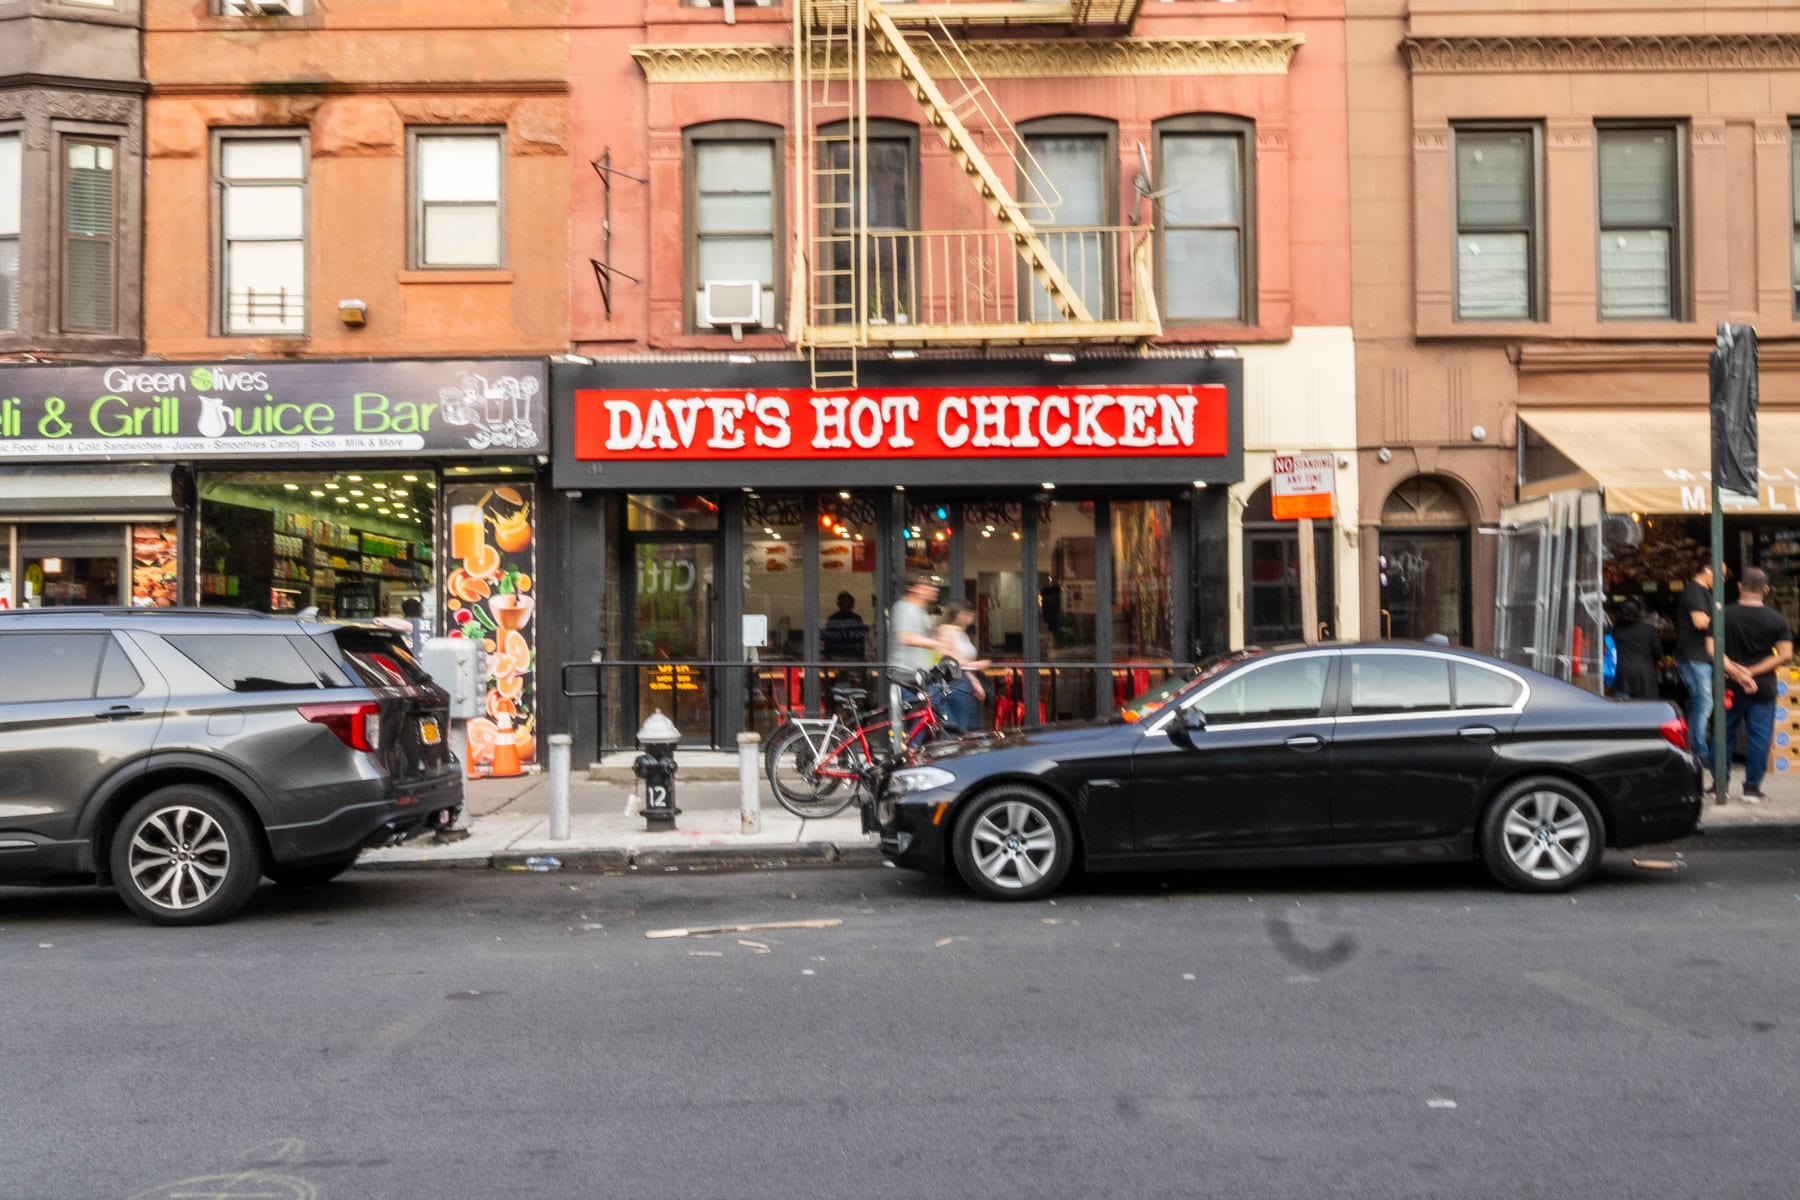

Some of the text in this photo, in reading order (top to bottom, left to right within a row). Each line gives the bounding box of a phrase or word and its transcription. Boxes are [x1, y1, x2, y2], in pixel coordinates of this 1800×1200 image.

[103, 367, 186, 393] Green
[0, 397, 21, 437] li
[38, 397, 73, 438] &
[89, 395, 180, 437] Grill
[353, 392, 438, 433] Bar
[603, 392, 1199, 450] DAVE'S HOT CHICKEN
[78, 441, 100, 452] Cold
[103, 441, 162, 451] Sandwiches
[172, 440, 205, 450] Juices
[214, 439, 267, 450] Smoothies
[270, 439, 300, 451] Candy
[310, 438, 337, 448] Soda
[345, 438, 365, 448] Milk
[378, 438, 404, 447] More
[1275, 457, 1293, 473] NO
[648, 786, 667, 808] 12
